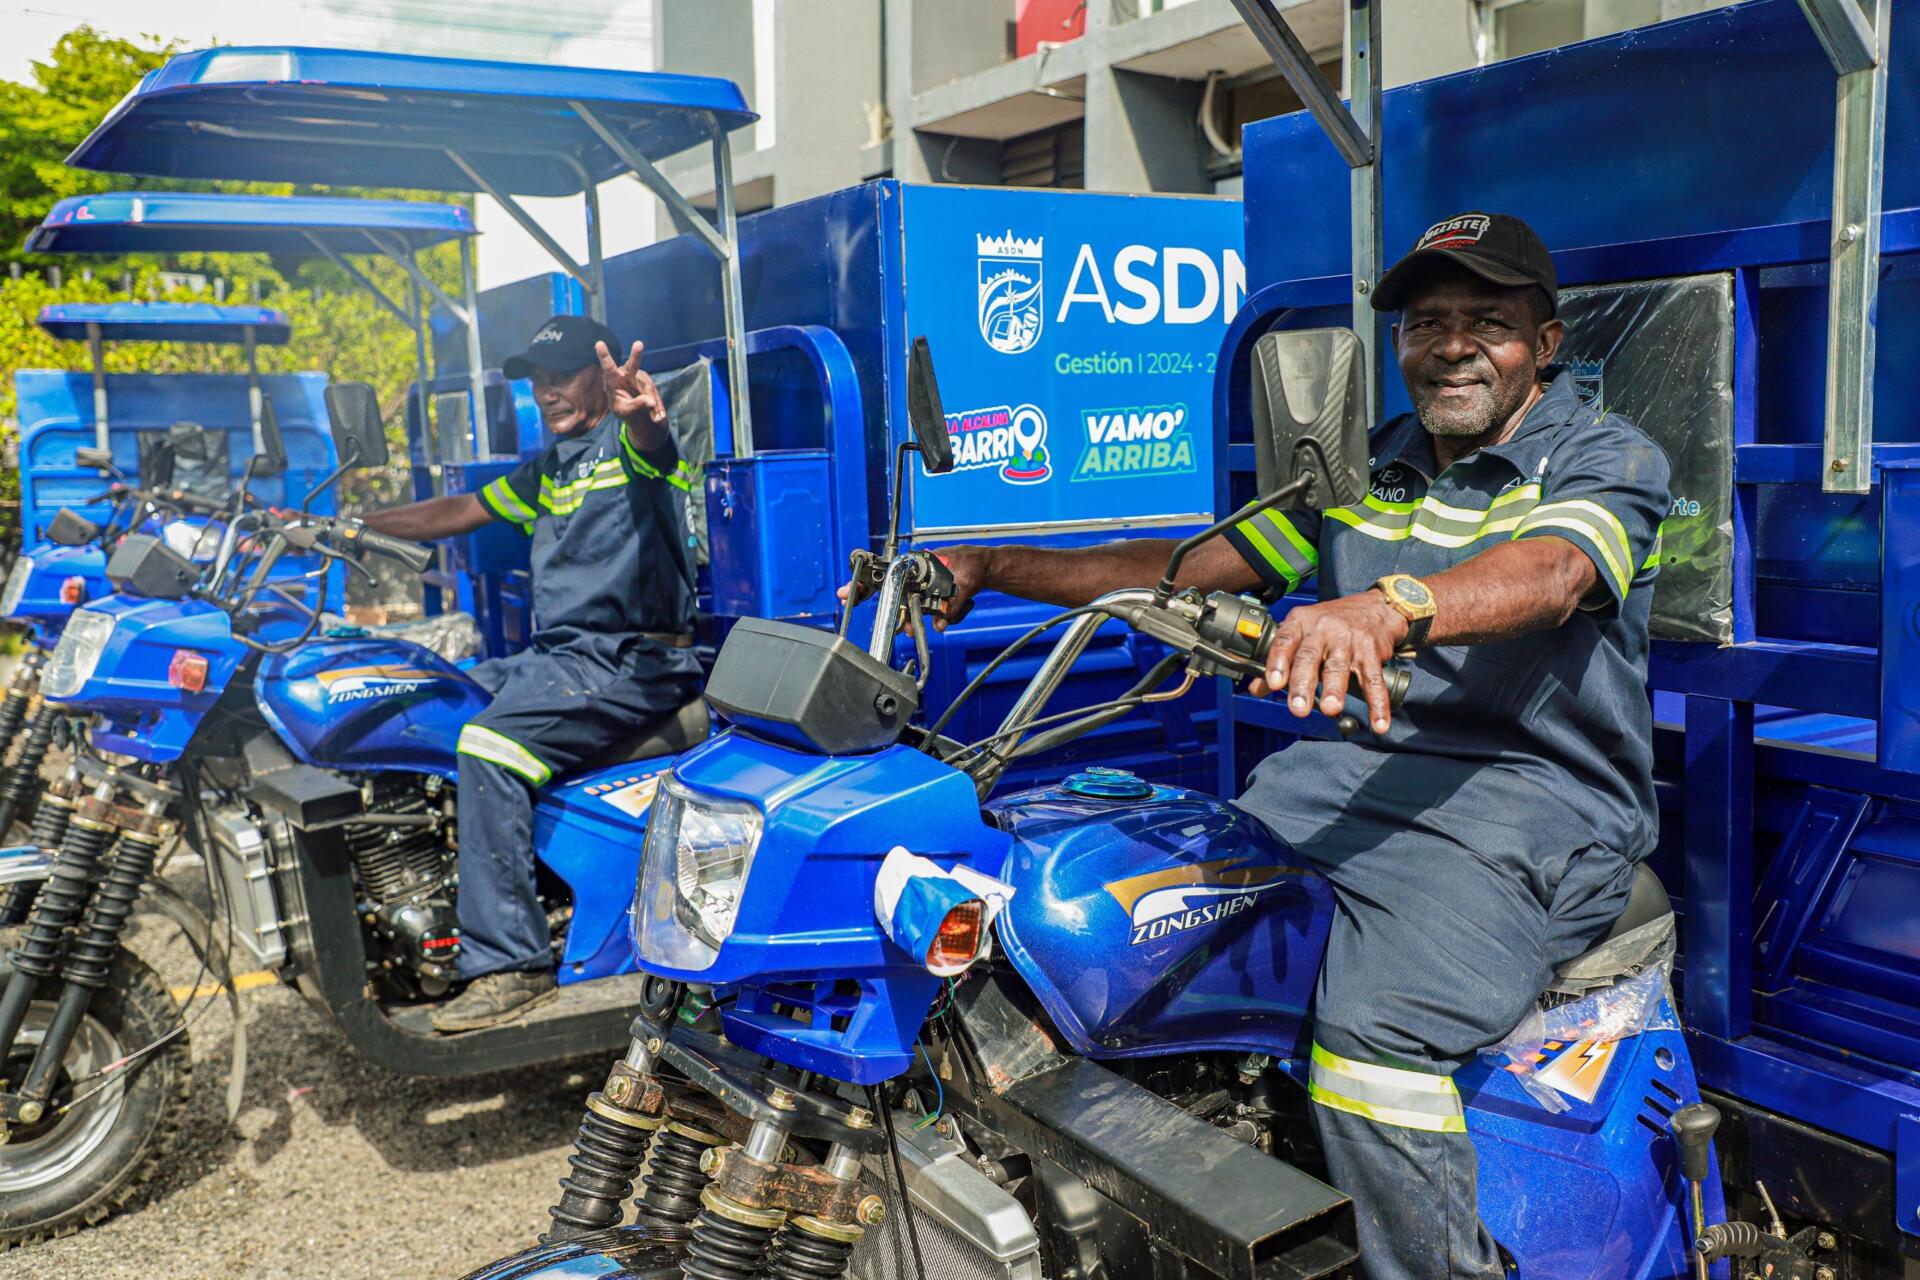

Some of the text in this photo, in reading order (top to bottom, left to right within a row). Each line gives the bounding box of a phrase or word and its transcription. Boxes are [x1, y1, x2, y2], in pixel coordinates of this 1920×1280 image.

[997, 246, 1023, 255] ASDN
[1055, 351, 1133, 375] Gestión
[1147, 352, 1194, 374] 2024
[1080, 441, 1191, 474] ARRIBA
[1131, 892, 1259, 945] ZONGSHEN
